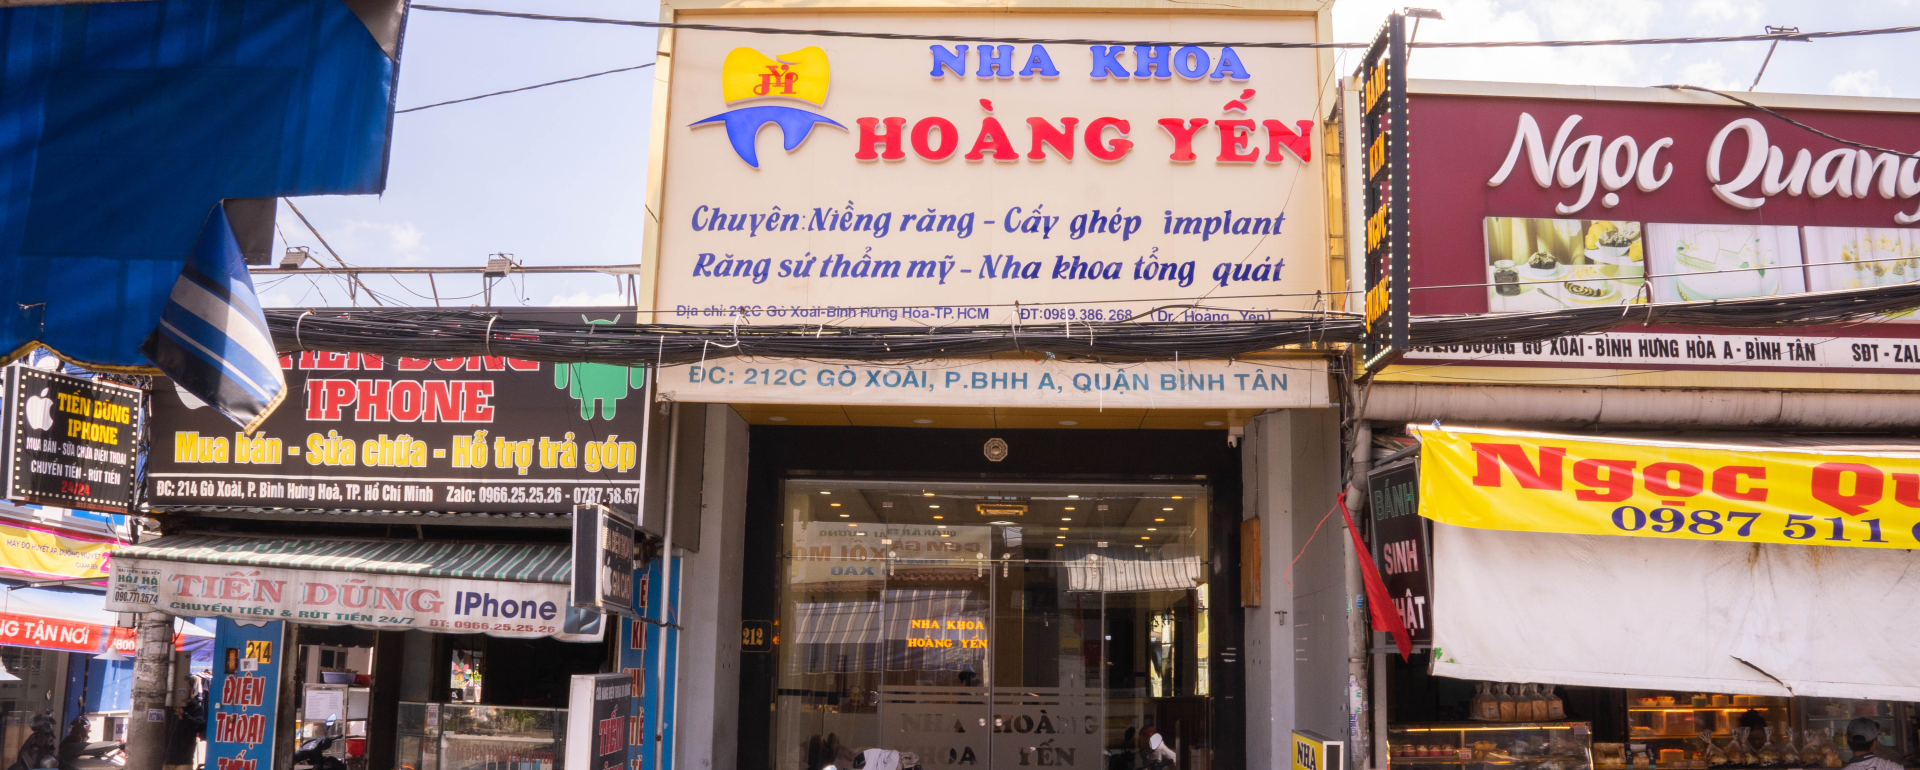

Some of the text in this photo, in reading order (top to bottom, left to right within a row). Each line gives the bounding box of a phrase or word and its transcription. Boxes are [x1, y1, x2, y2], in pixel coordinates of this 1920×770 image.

[930, 44, 1251, 81] NHA KHOA
[1365, 57, 1387, 116] BÁNH
[855, 88, 1314, 165] HOÀNG YẾN
[1369, 130, 1386, 182] KEM
[1487, 111, 1920, 226] Ngọc Quang
[808, 200, 892, 238] Niềng
[900, 207, 975, 239] răng
[1003, 204, 1060, 240] Cấy
[1069, 206, 1142, 242] ghép
[1164, 209, 1286, 242] implant
[1367, 203, 1388, 255] NGỌC
[692, 246, 1286, 288] Răng sứ thẩm mỹ Nha khoa tổng quát
[766, 305, 786, 318] Gò
[860, 305, 898, 321] Hưng
[1365, 274, 1390, 335] QUANG
[1596, 333, 1633, 358] BÌNH
[1638, 338, 1679, 359] HƯNG
[1686, 336, 1716, 359] HÒA
[1723, 340, 1734, 359] A
[1745, 338, 1782, 361] BÌNH
[1787, 339, 1816, 362] TÂN
[1852, 343, 1879, 363] SĐT
[689, 365, 1287, 395] ĐC: 212C GÒ XOÀI, P.BHH A, QUẬN BÌNH TÂN
[58, 390, 91, 417] TIẾN
[306, 379, 495, 424] IPHONE
[67, 418, 118, 445] IPHONE
[26, 437, 42, 451] MUA
[42, 438, 57, 454] BÁN
[109, 451, 127, 468] THOẠI
[174, 429, 637, 476] Mua bán Sửa chữa Hỗ trợ trả góp
[30, 458, 63, 476] CHUYỂN
[88, 467, 103, 483] RÚT
[1470, 442, 1769, 507] Ngọc
[61, 480, 91, 496] 24/24
[156, 480, 433, 503] ĐC: 214 Gò Xoài, P. Bình Hưng Hoà, TP. Hồ Chí Minh
[446, 486, 476, 503] Zalo:
[479, 487, 562, 504] 0966.25.25.26
[1374, 478, 1416, 521] BÁNH
[1611, 505, 1762, 537] 0987
[1782, 513, 1889, 543] 511
[6, 537, 19, 548] MÁY
[1383, 539, 1419, 576] SINH
[118, 573, 158, 585] HẢI HÀ
[168, 570, 557, 620] TIẾN DŨNG IPhone
[169, 601, 234, 614] CHUYỂN
[298, 608, 331, 620] RÚT
[377, 615, 415, 625] 24/7
[429, 619, 556, 634] ĐT: 0966.25.25.26
[911, 619, 985, 630] NHA KHOA
[24, 620, 58, 645] TẬN
[60, 626, 90, 645] NƠI
[742, 627, 764, 646] 212
[907, 634, 989, 649] HOÀNG YẾN
[246, 641, 272, 663] 214
[222, 671, 266, 711] ĐIỆN
[215, 712, 266, 750] THOẠI
[599, 704, 625, 756] TIẾN
[1018, 738, 1076, 767] YẾN
[1296, 740, 1318, 770] NHA
